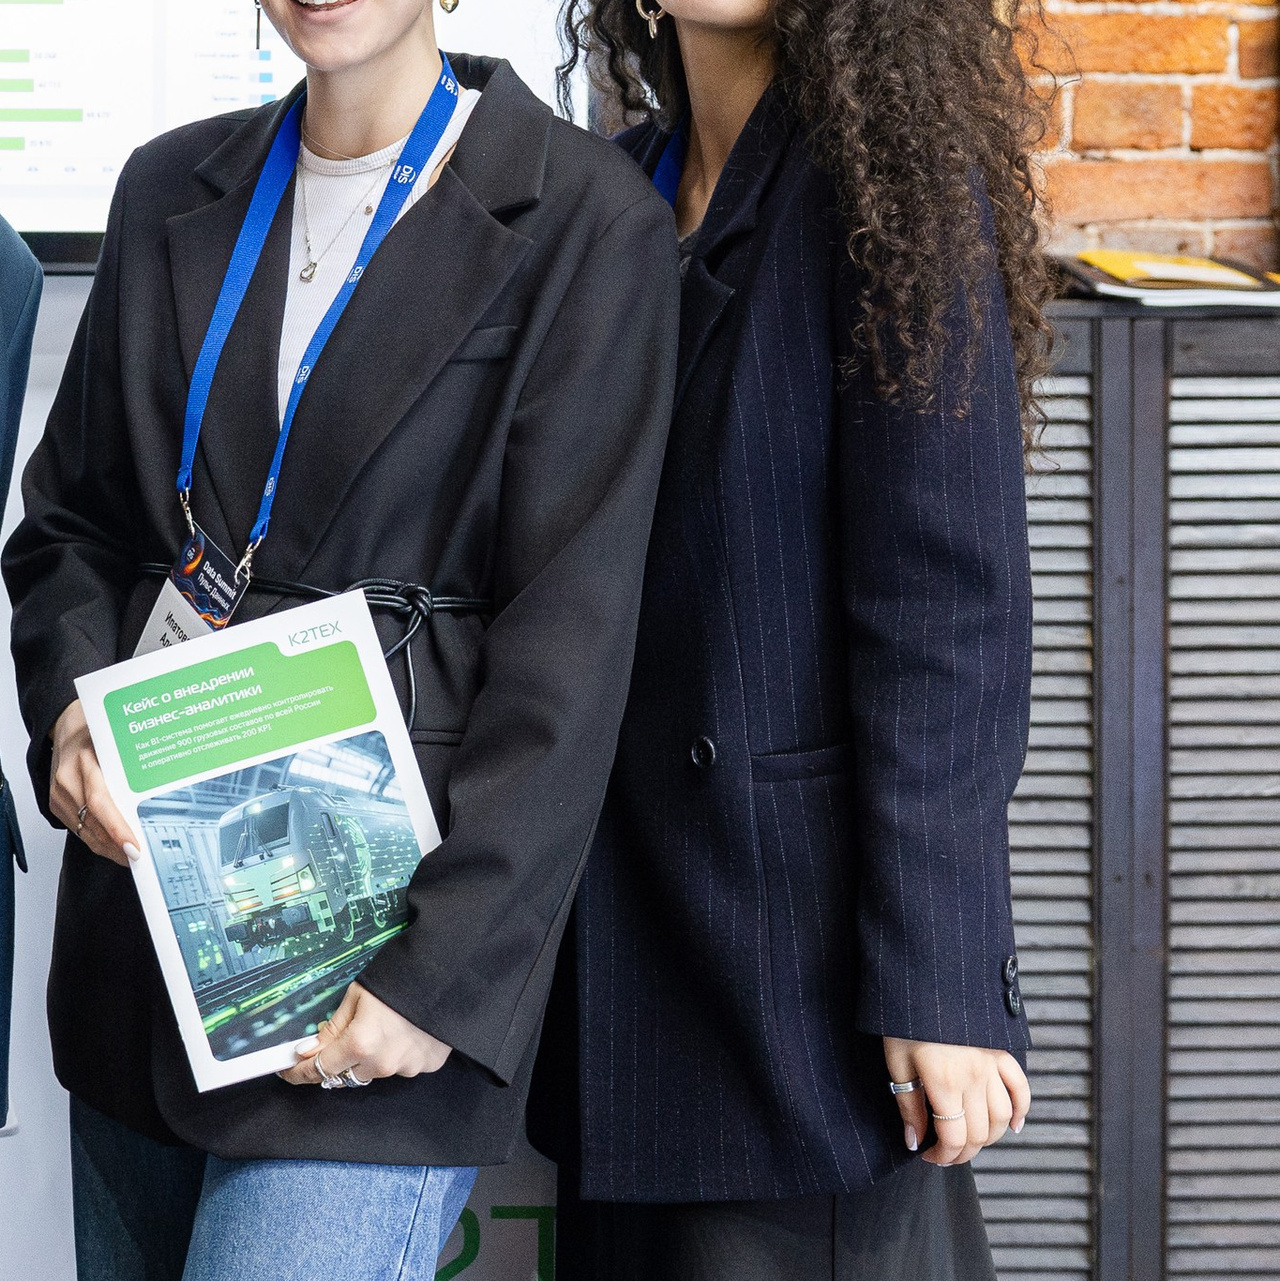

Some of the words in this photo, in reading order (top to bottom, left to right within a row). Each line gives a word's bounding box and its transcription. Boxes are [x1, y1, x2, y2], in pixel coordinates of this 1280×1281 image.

[197, 572, 213, 593] Пульс
[210, 590, 230, 611] Данных
[203, 561, 217, 581] Data
[214, 574, 237, 600] Summit
[122, 695, 160, 716] Кейс
[161, 693, 171, 703] о
[173, 666, 255, 700] внедрении
[128, 684, 263, 734] бизнес-аналитики
[135, 740, 150, 751] Как
[194, 716, 227, 734] помогает
[229, 704, 272, 721] ежедневно
[272, 685, 334, 707] контролировать
[138, 743, 177, 761] движение
[177, 738, 192, 748] 900
[192, 728, 229, 745] грузовых
[229, 717, 263, 733] составов
[264, 713, 275, 722] по
[275, 707, 293, 718] всей
[294, 699, 321, 712] России
[148, 750, 192, 769] оперативно
[192, 737, 242, 754] отслеживать
[242, 728, 257, 739] 200
[257, 723, 273, 734] KPI
